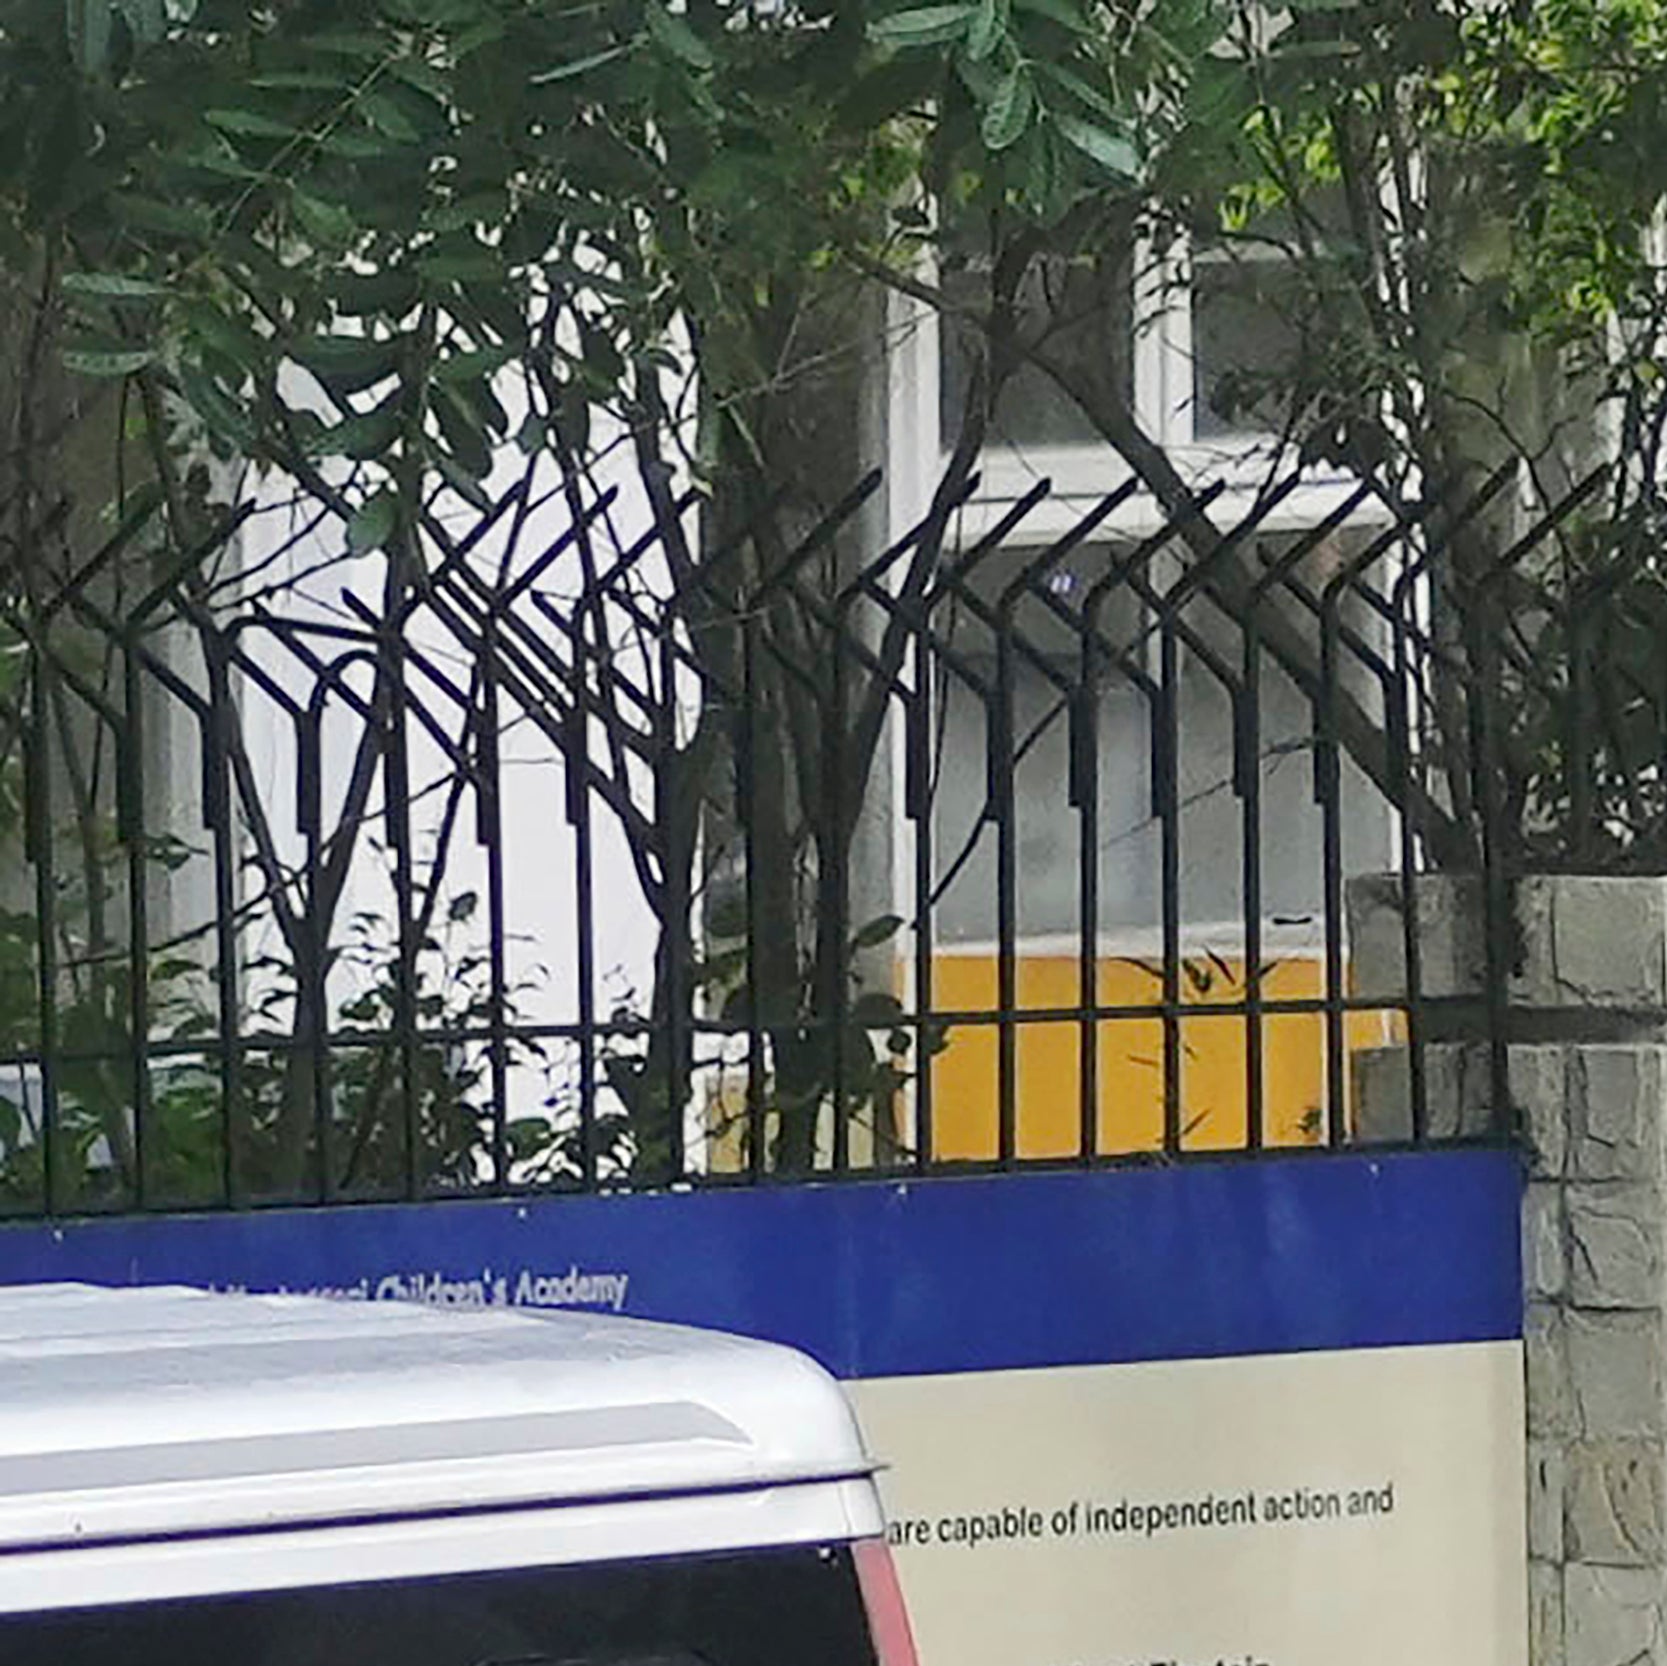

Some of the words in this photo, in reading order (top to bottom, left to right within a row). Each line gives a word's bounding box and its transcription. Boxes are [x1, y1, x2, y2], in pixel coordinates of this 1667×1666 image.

[515, 1265, 629, 1312] Academy
[889, 1512, 931, 1547] are
[936, 1504, 1044, 1551] capable
[1051, 1499, 1079, 1536] of
[1085, 1490, 1258, 1533] independent
[1262, 1486, 1342, 1522] action
[1346, 1481, 1395, 1515] and
